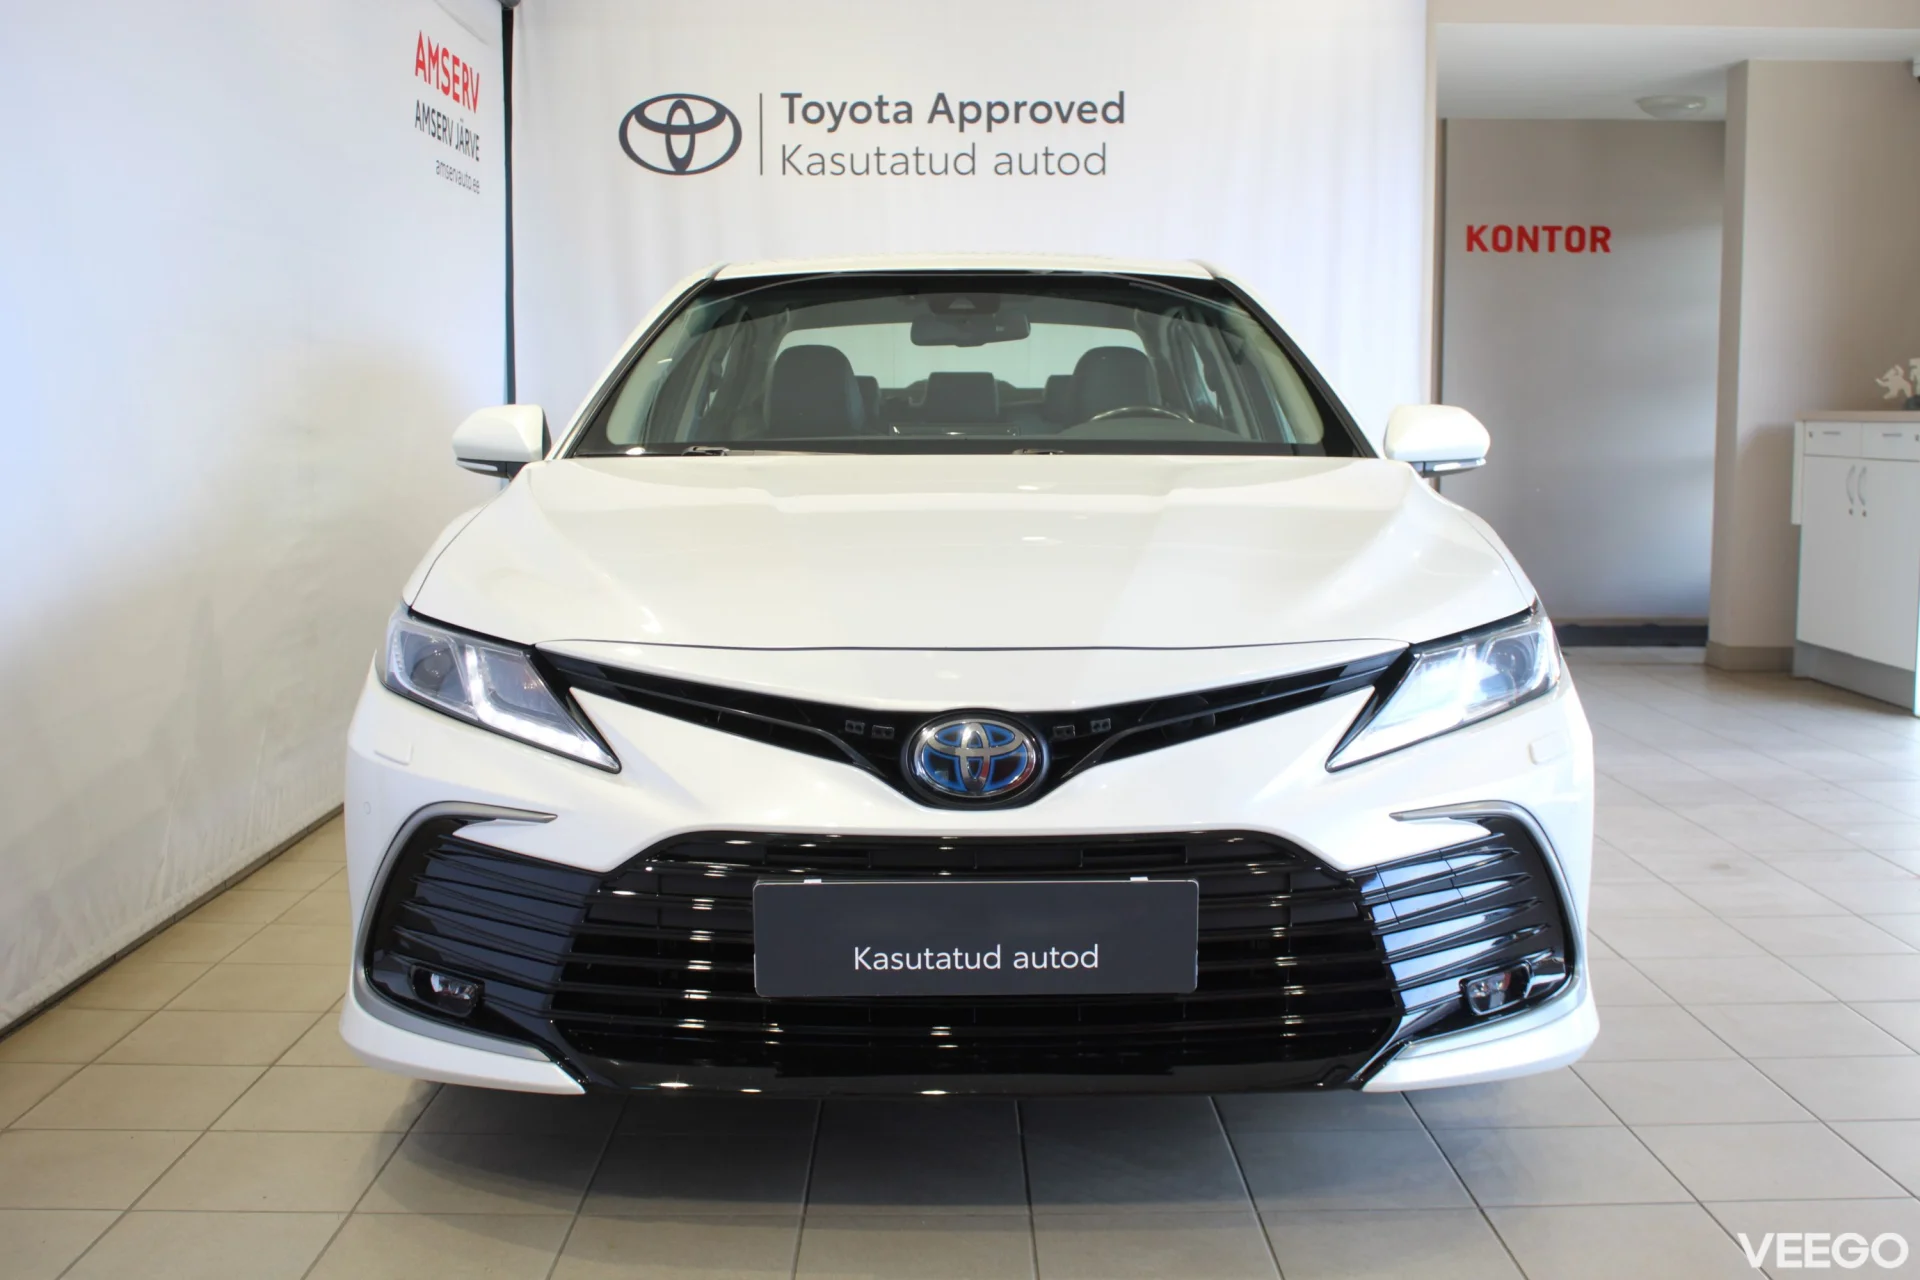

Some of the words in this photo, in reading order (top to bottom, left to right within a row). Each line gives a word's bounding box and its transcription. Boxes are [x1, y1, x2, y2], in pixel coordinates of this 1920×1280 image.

[415, 30, 480, 114] AMSERV
[780, 92, 913, 133] Toyota
[927, 90, 1126, 133] Approved
[414, 99, 454, 147] AMSERV
[455, 117, 480, 162] JÄRVE
[435, 159, 480, 195] amservauto.ee
[780, 142, 977, 176] Kasutatud
[993, 142, 1107, 176] autod
[1466, 224, 1612, 254] KONTOR
[853, 943, 1001, 971] Kasutatud
[1013, 943, 1100, 970] autod
